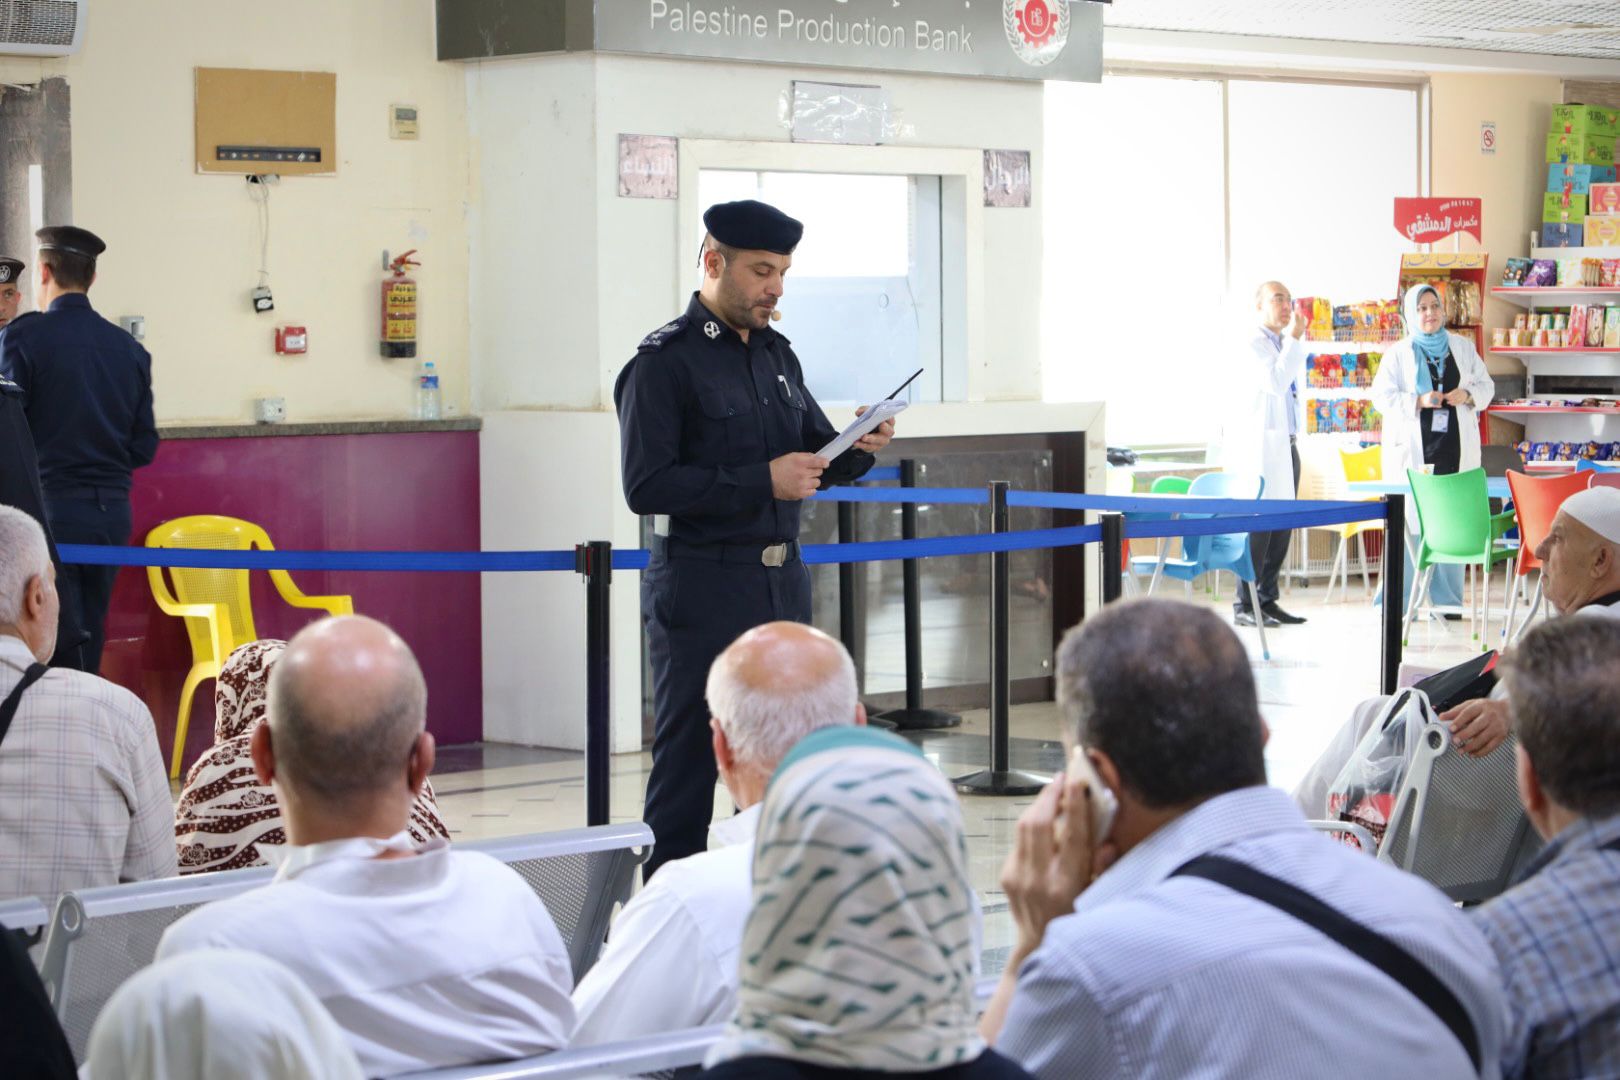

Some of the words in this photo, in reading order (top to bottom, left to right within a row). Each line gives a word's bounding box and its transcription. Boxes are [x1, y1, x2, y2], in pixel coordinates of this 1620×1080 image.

[650, 0, 768, 38] Palestine
[778, 9, 905, 47] Production
[915, 20, 974, 53] Bank
[1406, 212, 1452, 241] الدمشقي
